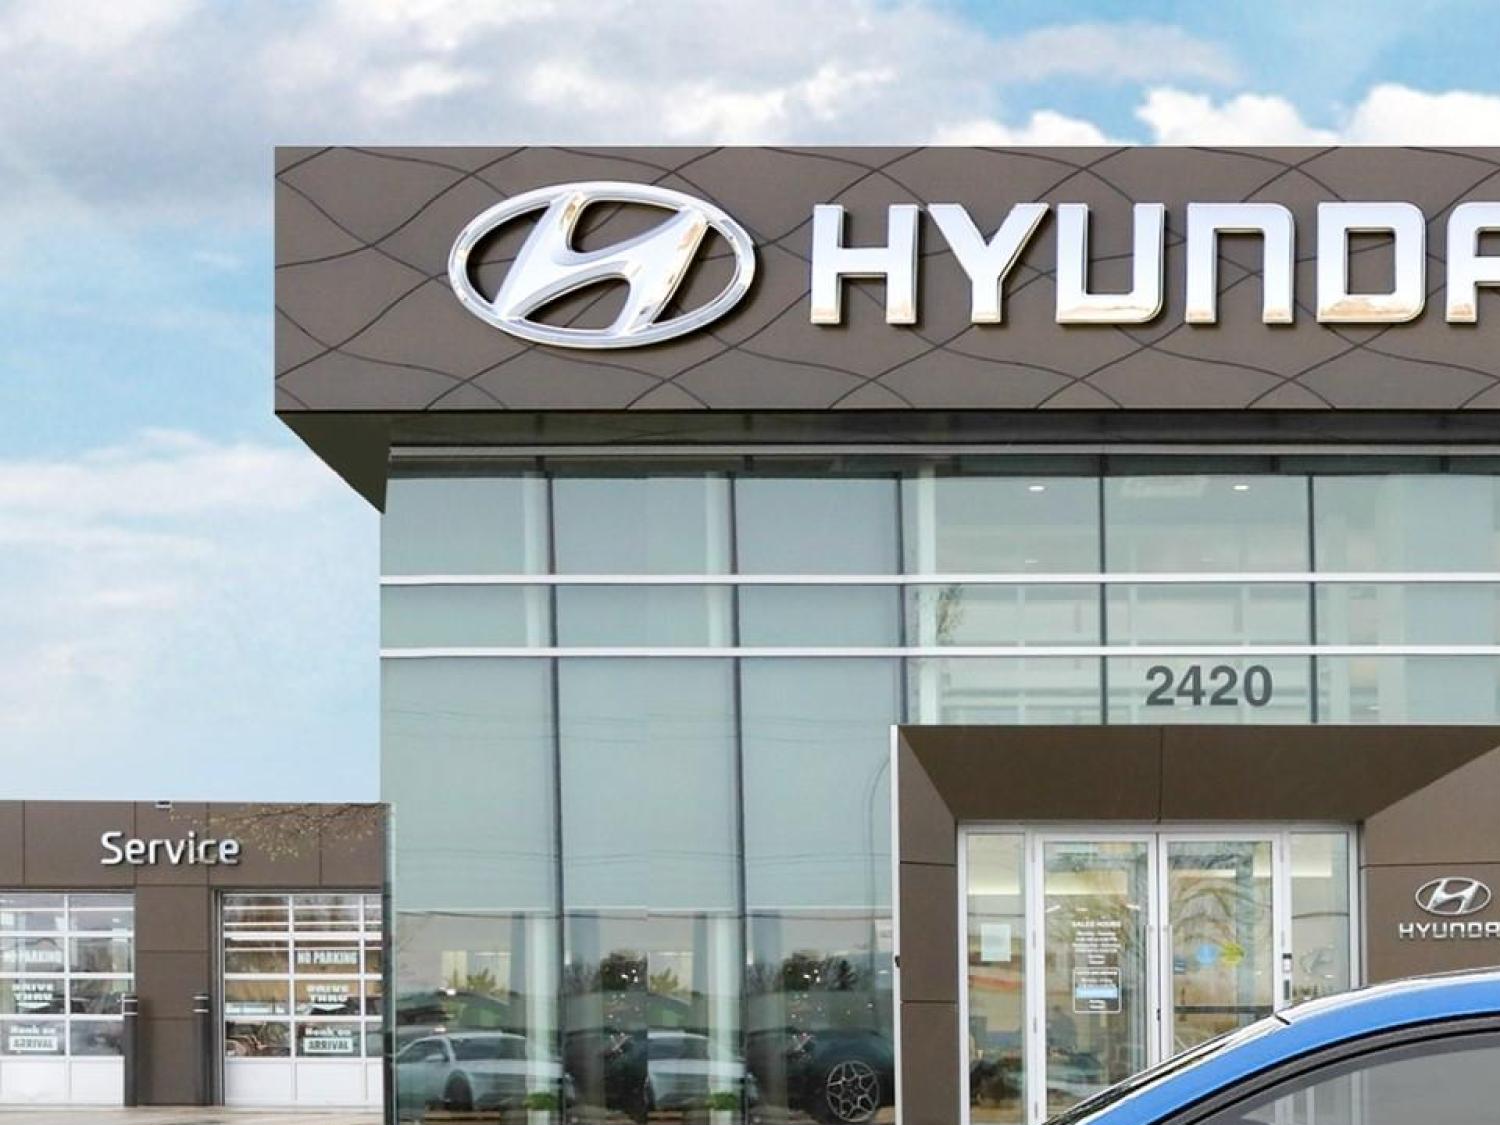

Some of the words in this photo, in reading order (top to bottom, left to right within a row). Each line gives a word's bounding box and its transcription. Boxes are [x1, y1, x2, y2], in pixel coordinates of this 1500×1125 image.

[1146, 665, 1273, 707] 2420
[101, 831, 240, 865] Service
[313, 951, 358, 964] PARKING
[13, 1038, 54, 1049] ARRIVAL
[308, 1040, 349, 1050] ARRIVAL
